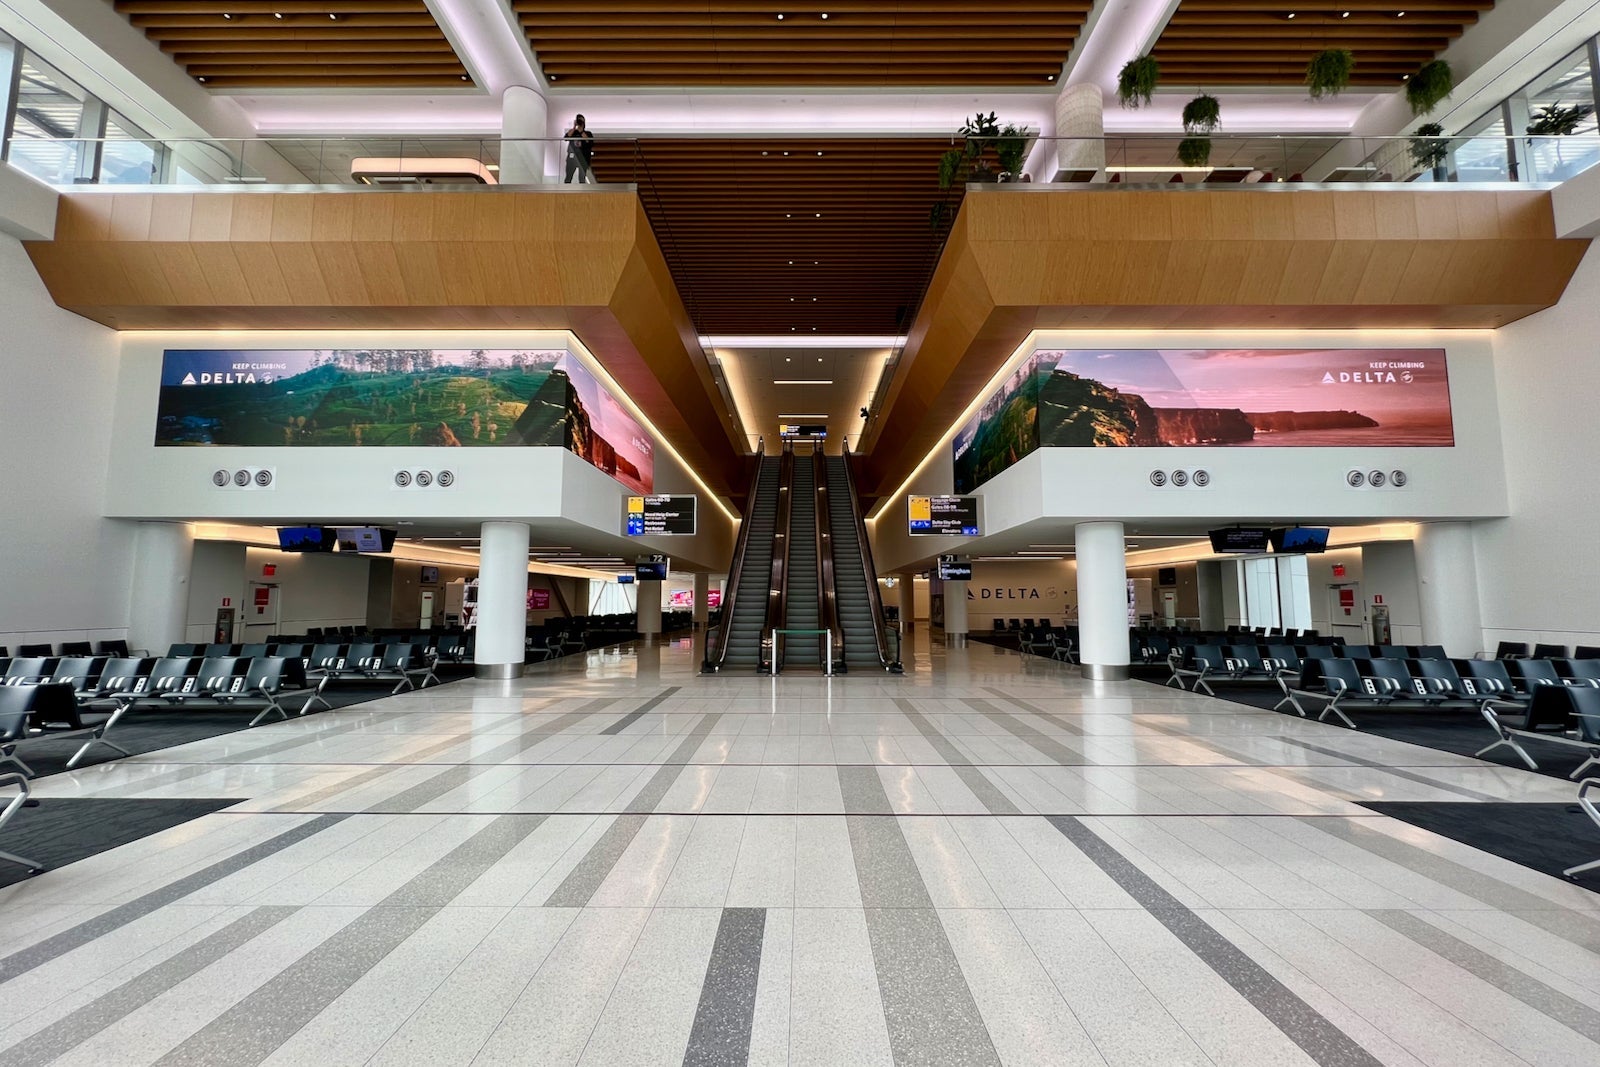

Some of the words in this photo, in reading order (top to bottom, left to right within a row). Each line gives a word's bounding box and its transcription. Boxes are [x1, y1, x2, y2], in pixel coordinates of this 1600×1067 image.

[201, 372, 256, 384] DELTA
[1339, 371, 1397, 383] DELTA
[653, 554, 663, 562] 72
[941, 568, 971, 576] Birmingham
[981, 588, 1040, 599] DELTA
